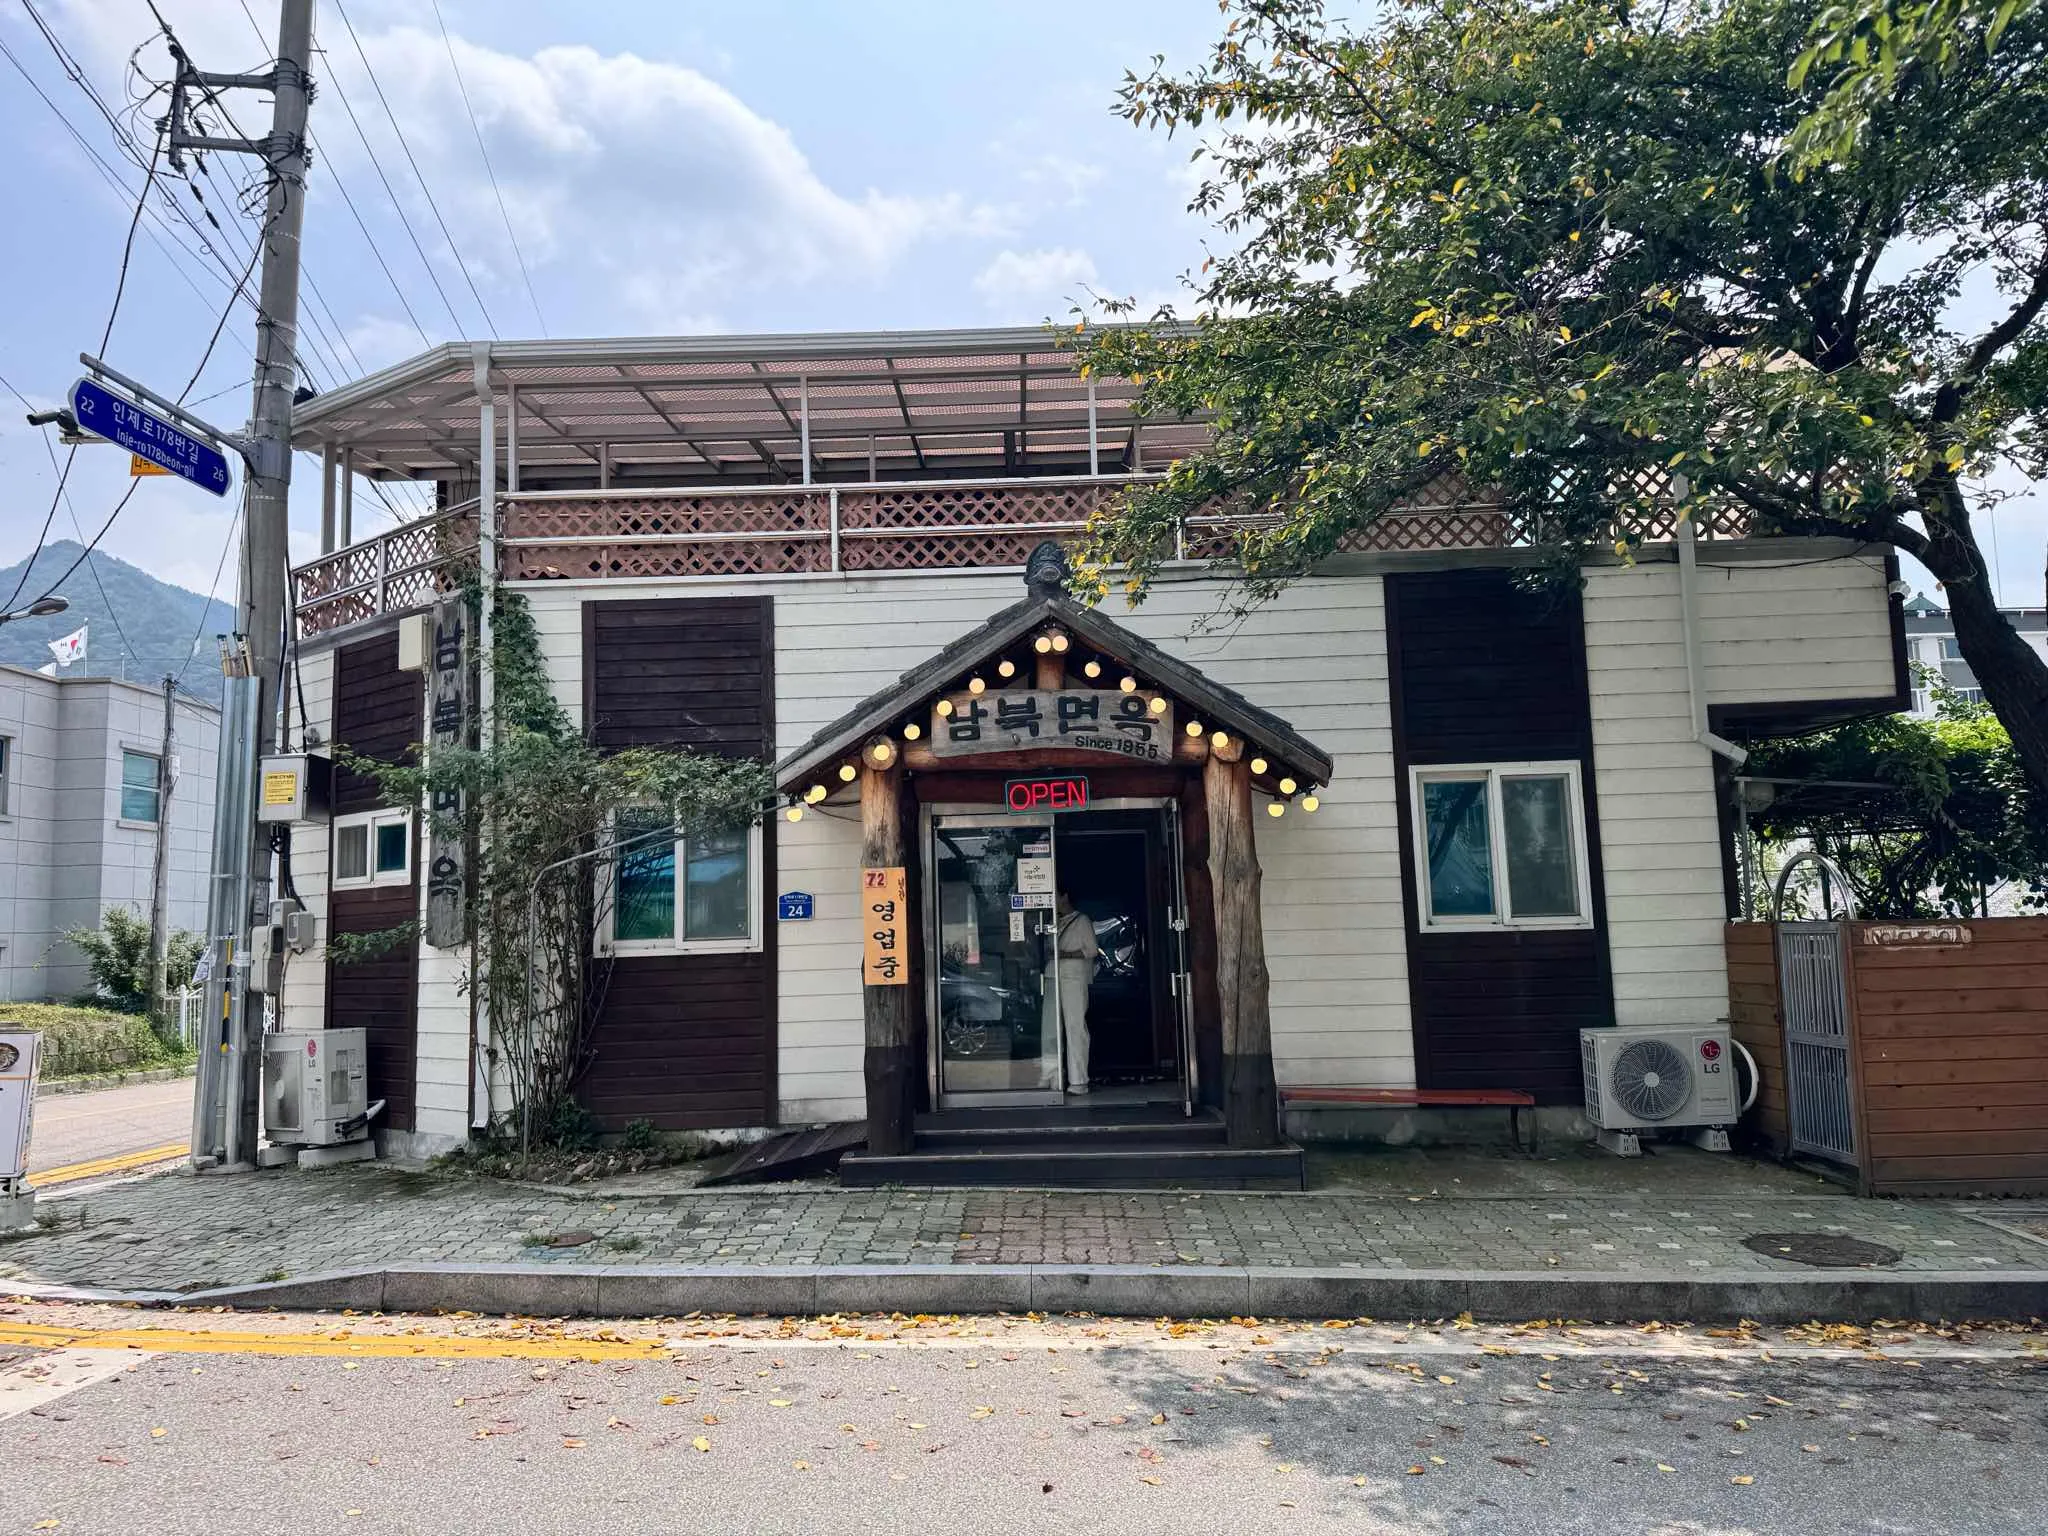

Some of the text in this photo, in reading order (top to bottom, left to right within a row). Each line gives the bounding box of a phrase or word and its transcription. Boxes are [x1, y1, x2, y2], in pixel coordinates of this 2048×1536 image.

[80, 396, 95, 415] 22
[112, 401, 200, 464] 인제로178번길
[213, 466, 225, 482] 26
[946, 695, 1160, 742] 남북면옥
[1075, 735, 1159, 759] Since 1955
[1009, 780, 1087, 811] OPEN
[867, 873, 885, 886] 72
[788, 905, 804, 917] 24
[872, 900, 900, 979] 영업중
[308, 1059, 316, 1068] LG
[1704, 1063, 1720, 1073] LG
